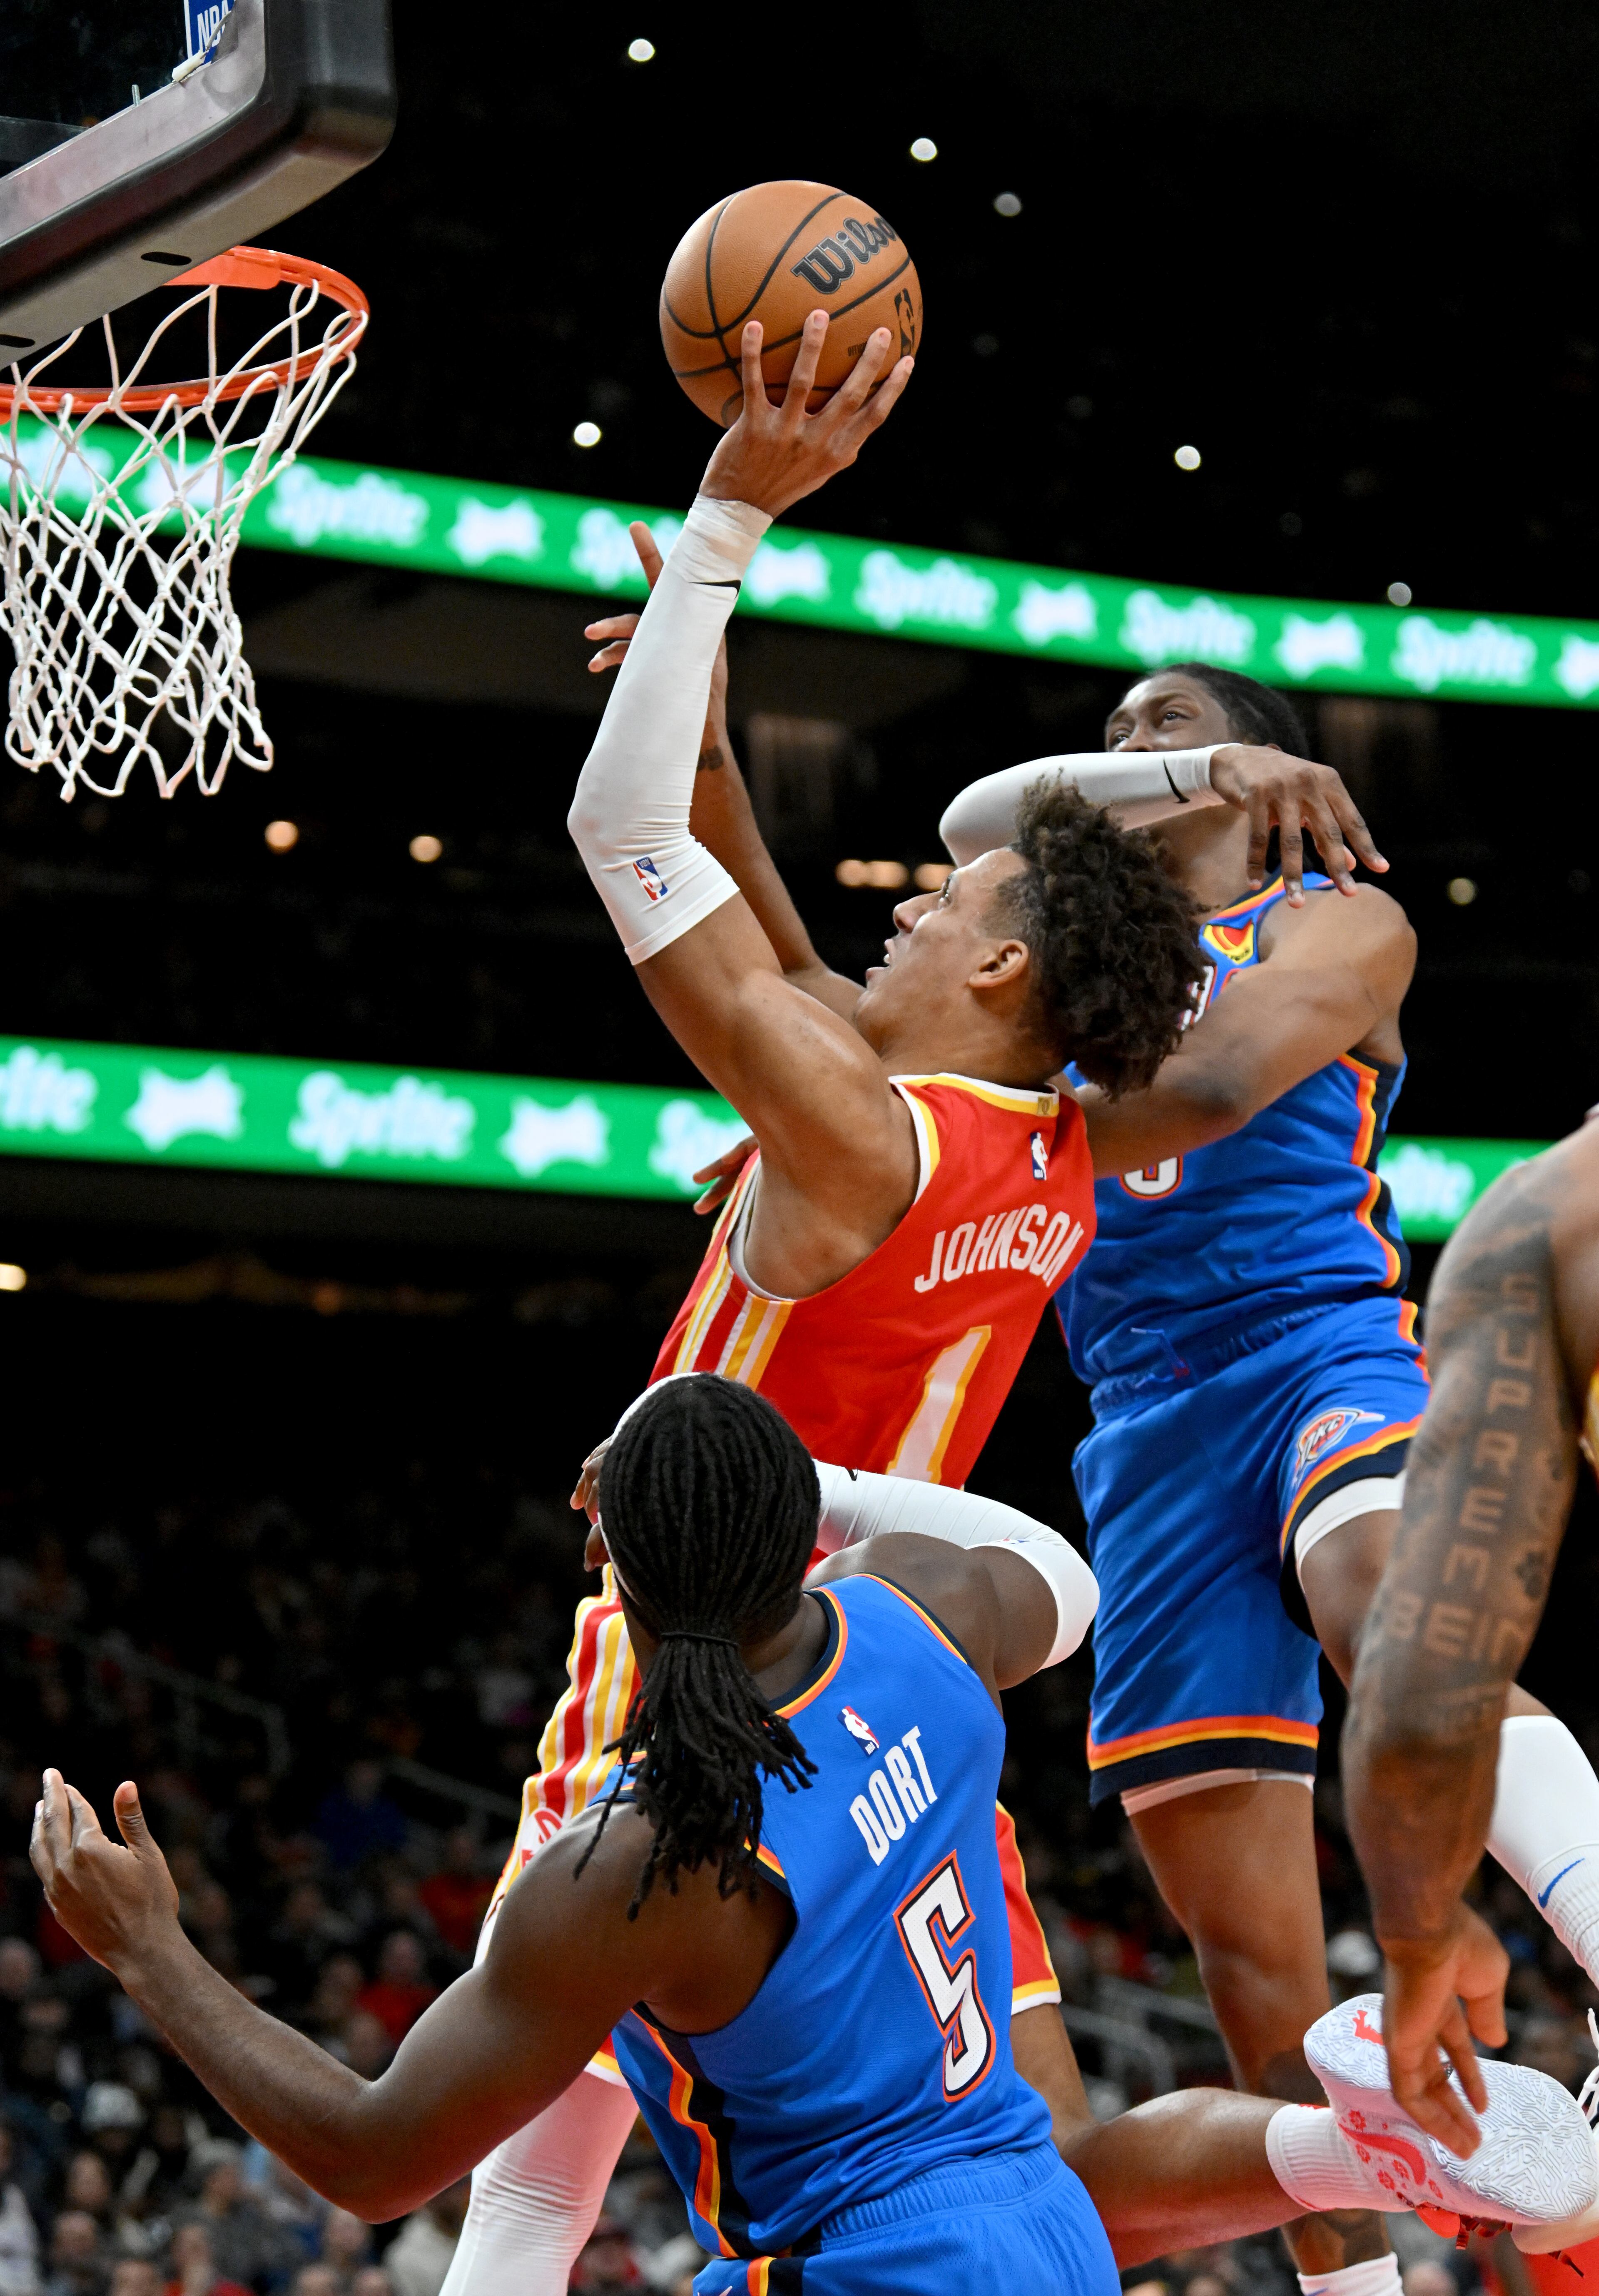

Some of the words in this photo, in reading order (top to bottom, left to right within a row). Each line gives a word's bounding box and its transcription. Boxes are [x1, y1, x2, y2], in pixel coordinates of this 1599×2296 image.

[197, 0, 229, 53] NBA
[790, 217, 897, 294] Wilso
[288, 1071, 476, 1167] Sprite
[914, 1203, 1084, 1293] JOHNSON
[886, 1325, 991, 1485] 1
[864, 1741, 876, 1755] NBA
[849, 1725, 938, 1866] DORT
[893, 1849, 996, 2103] 5
